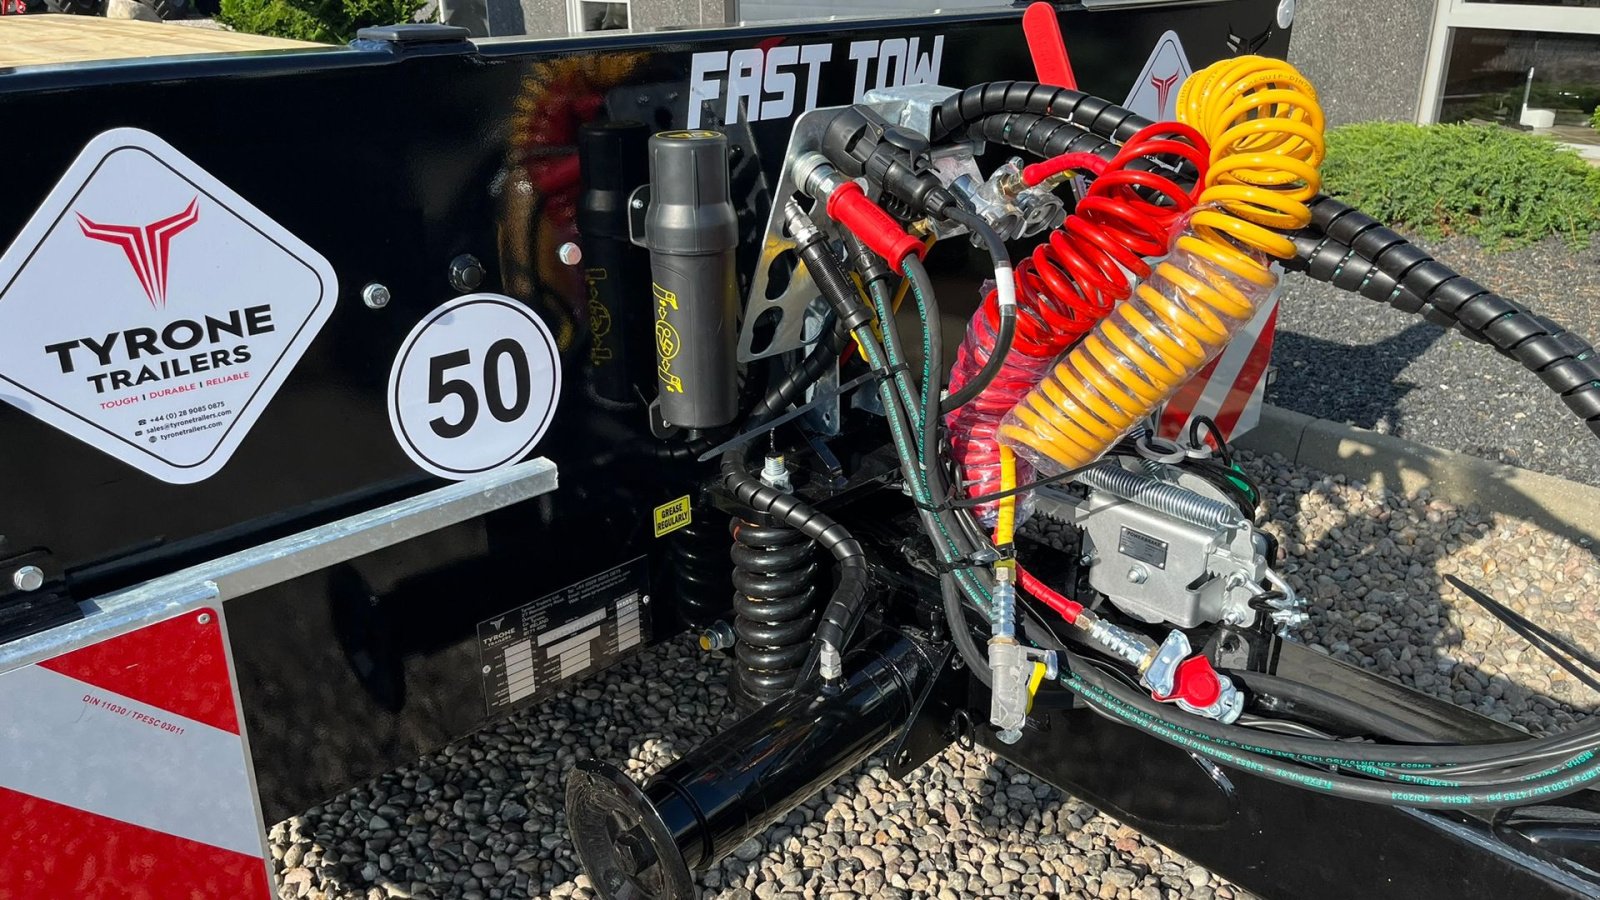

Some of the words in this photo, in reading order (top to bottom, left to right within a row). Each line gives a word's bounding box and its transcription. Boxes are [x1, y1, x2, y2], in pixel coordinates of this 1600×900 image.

[687, 43, 833, 130] FAST
[848, 34, 945, 104] TOW
[45, 304, 275, 373] TYRONE
[87, 345, 251, 394] TRAILERS
[100, 395, 139, 411] TOUGH
[150, 383, 196, 399] DURABLE
[206, 371, 250, 387] RELIABLE
[428, 338, 531, 439] 50
[146, 409, 232, 434] sales@tyronetrailers.com
[150, 415, 165, 423] +44
[165, 412, 177, 420] (0)
[178, 409, 188, 417] 28
[188, 404, 207, 415] 9085
[207, 401, 225, 410] 0875
[160, 421, 223, 441] tyronetrailers.com
[657, 511, 688, 530] REGULARLY
[661, 503, 683, 518] GREASE
[483, 627, 516, 645] TYRONE
[82, 694, 101, 706] DIN
[101, 701, 127, 715] 11030
[132, 711, 161, 727] TPESC
[161, 722, 185, 735] 03011
[1565, 749, 1594, 769] MSHA
[1534, 784, 1551, 796] bar
[1552, 779, 1570, 791] 330
[1439, 794, 1474, 804] MSHA
[1503, 790, 1527, 801] 4785
